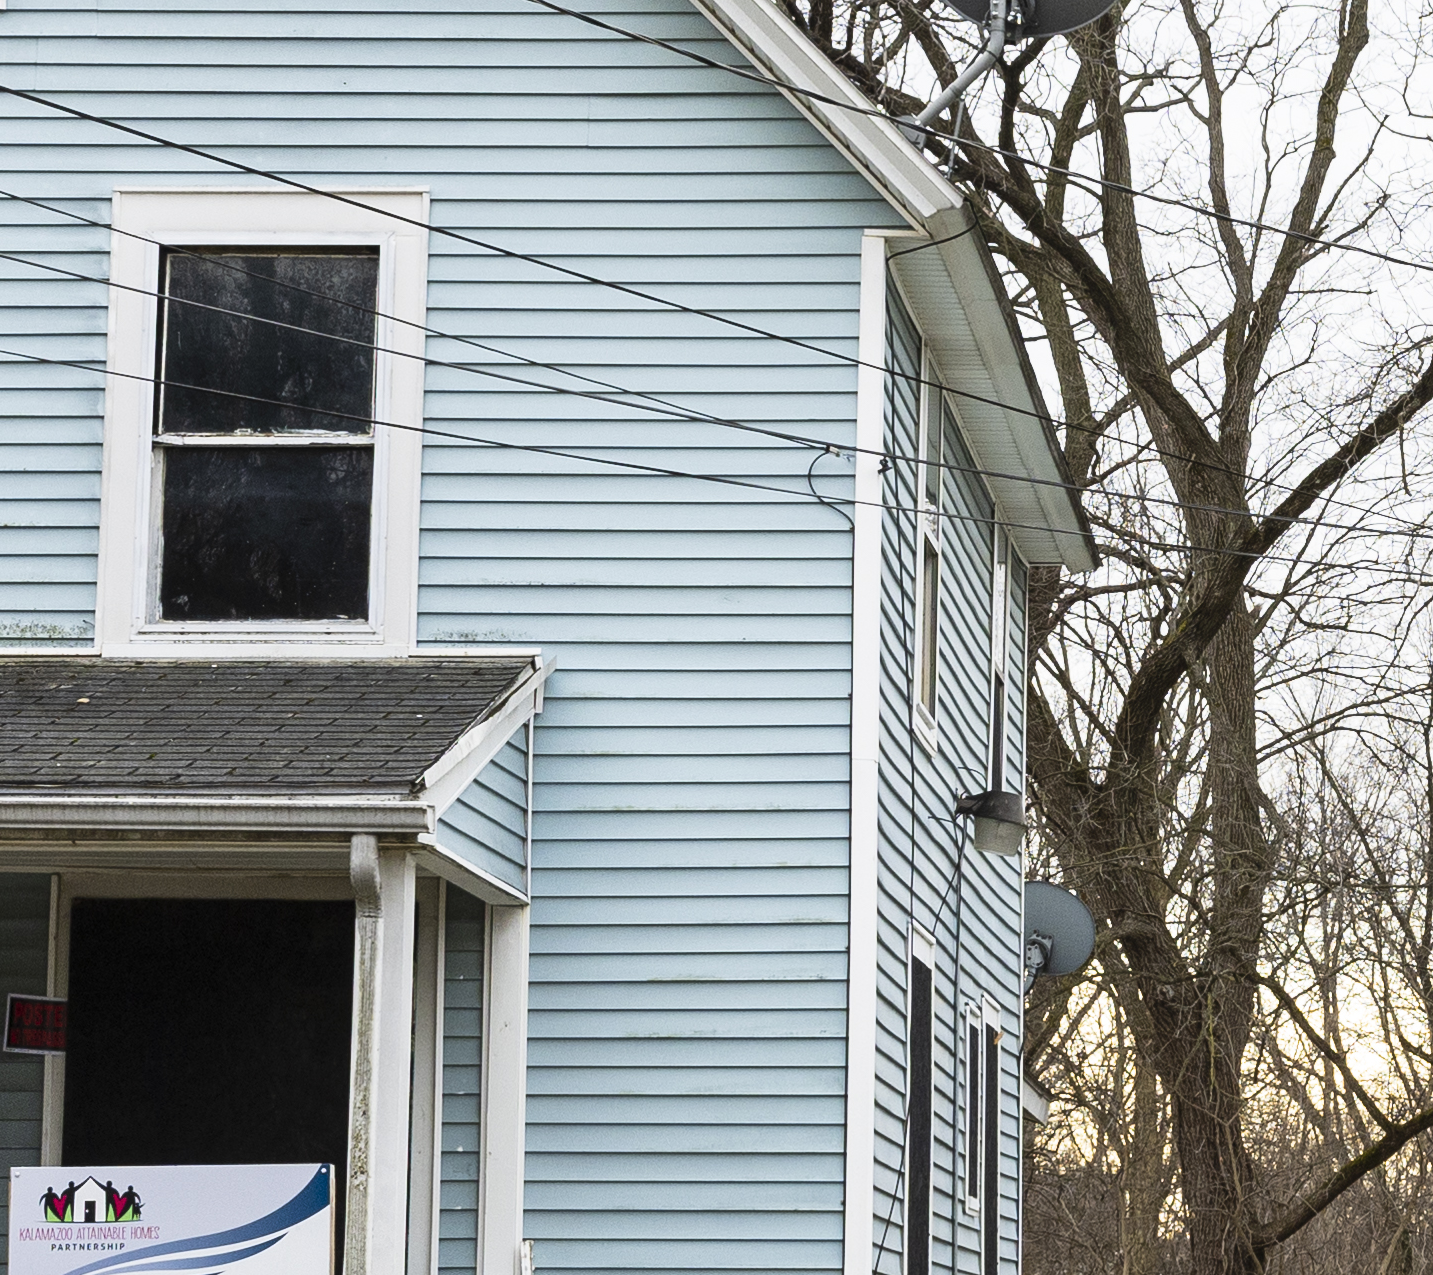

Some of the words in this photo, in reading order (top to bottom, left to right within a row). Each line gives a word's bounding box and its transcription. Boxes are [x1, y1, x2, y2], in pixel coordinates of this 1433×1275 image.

[14, 1002, 67, 1028] POSTE
[19, 1227, 72, 1241] KALAMAZOO
[76, 1227, 127, 1241] ATTAINABLE
[130, 1226, 160, 1240] HOMES
[51, 1242, 125, 1251] PARTNERSHIP
